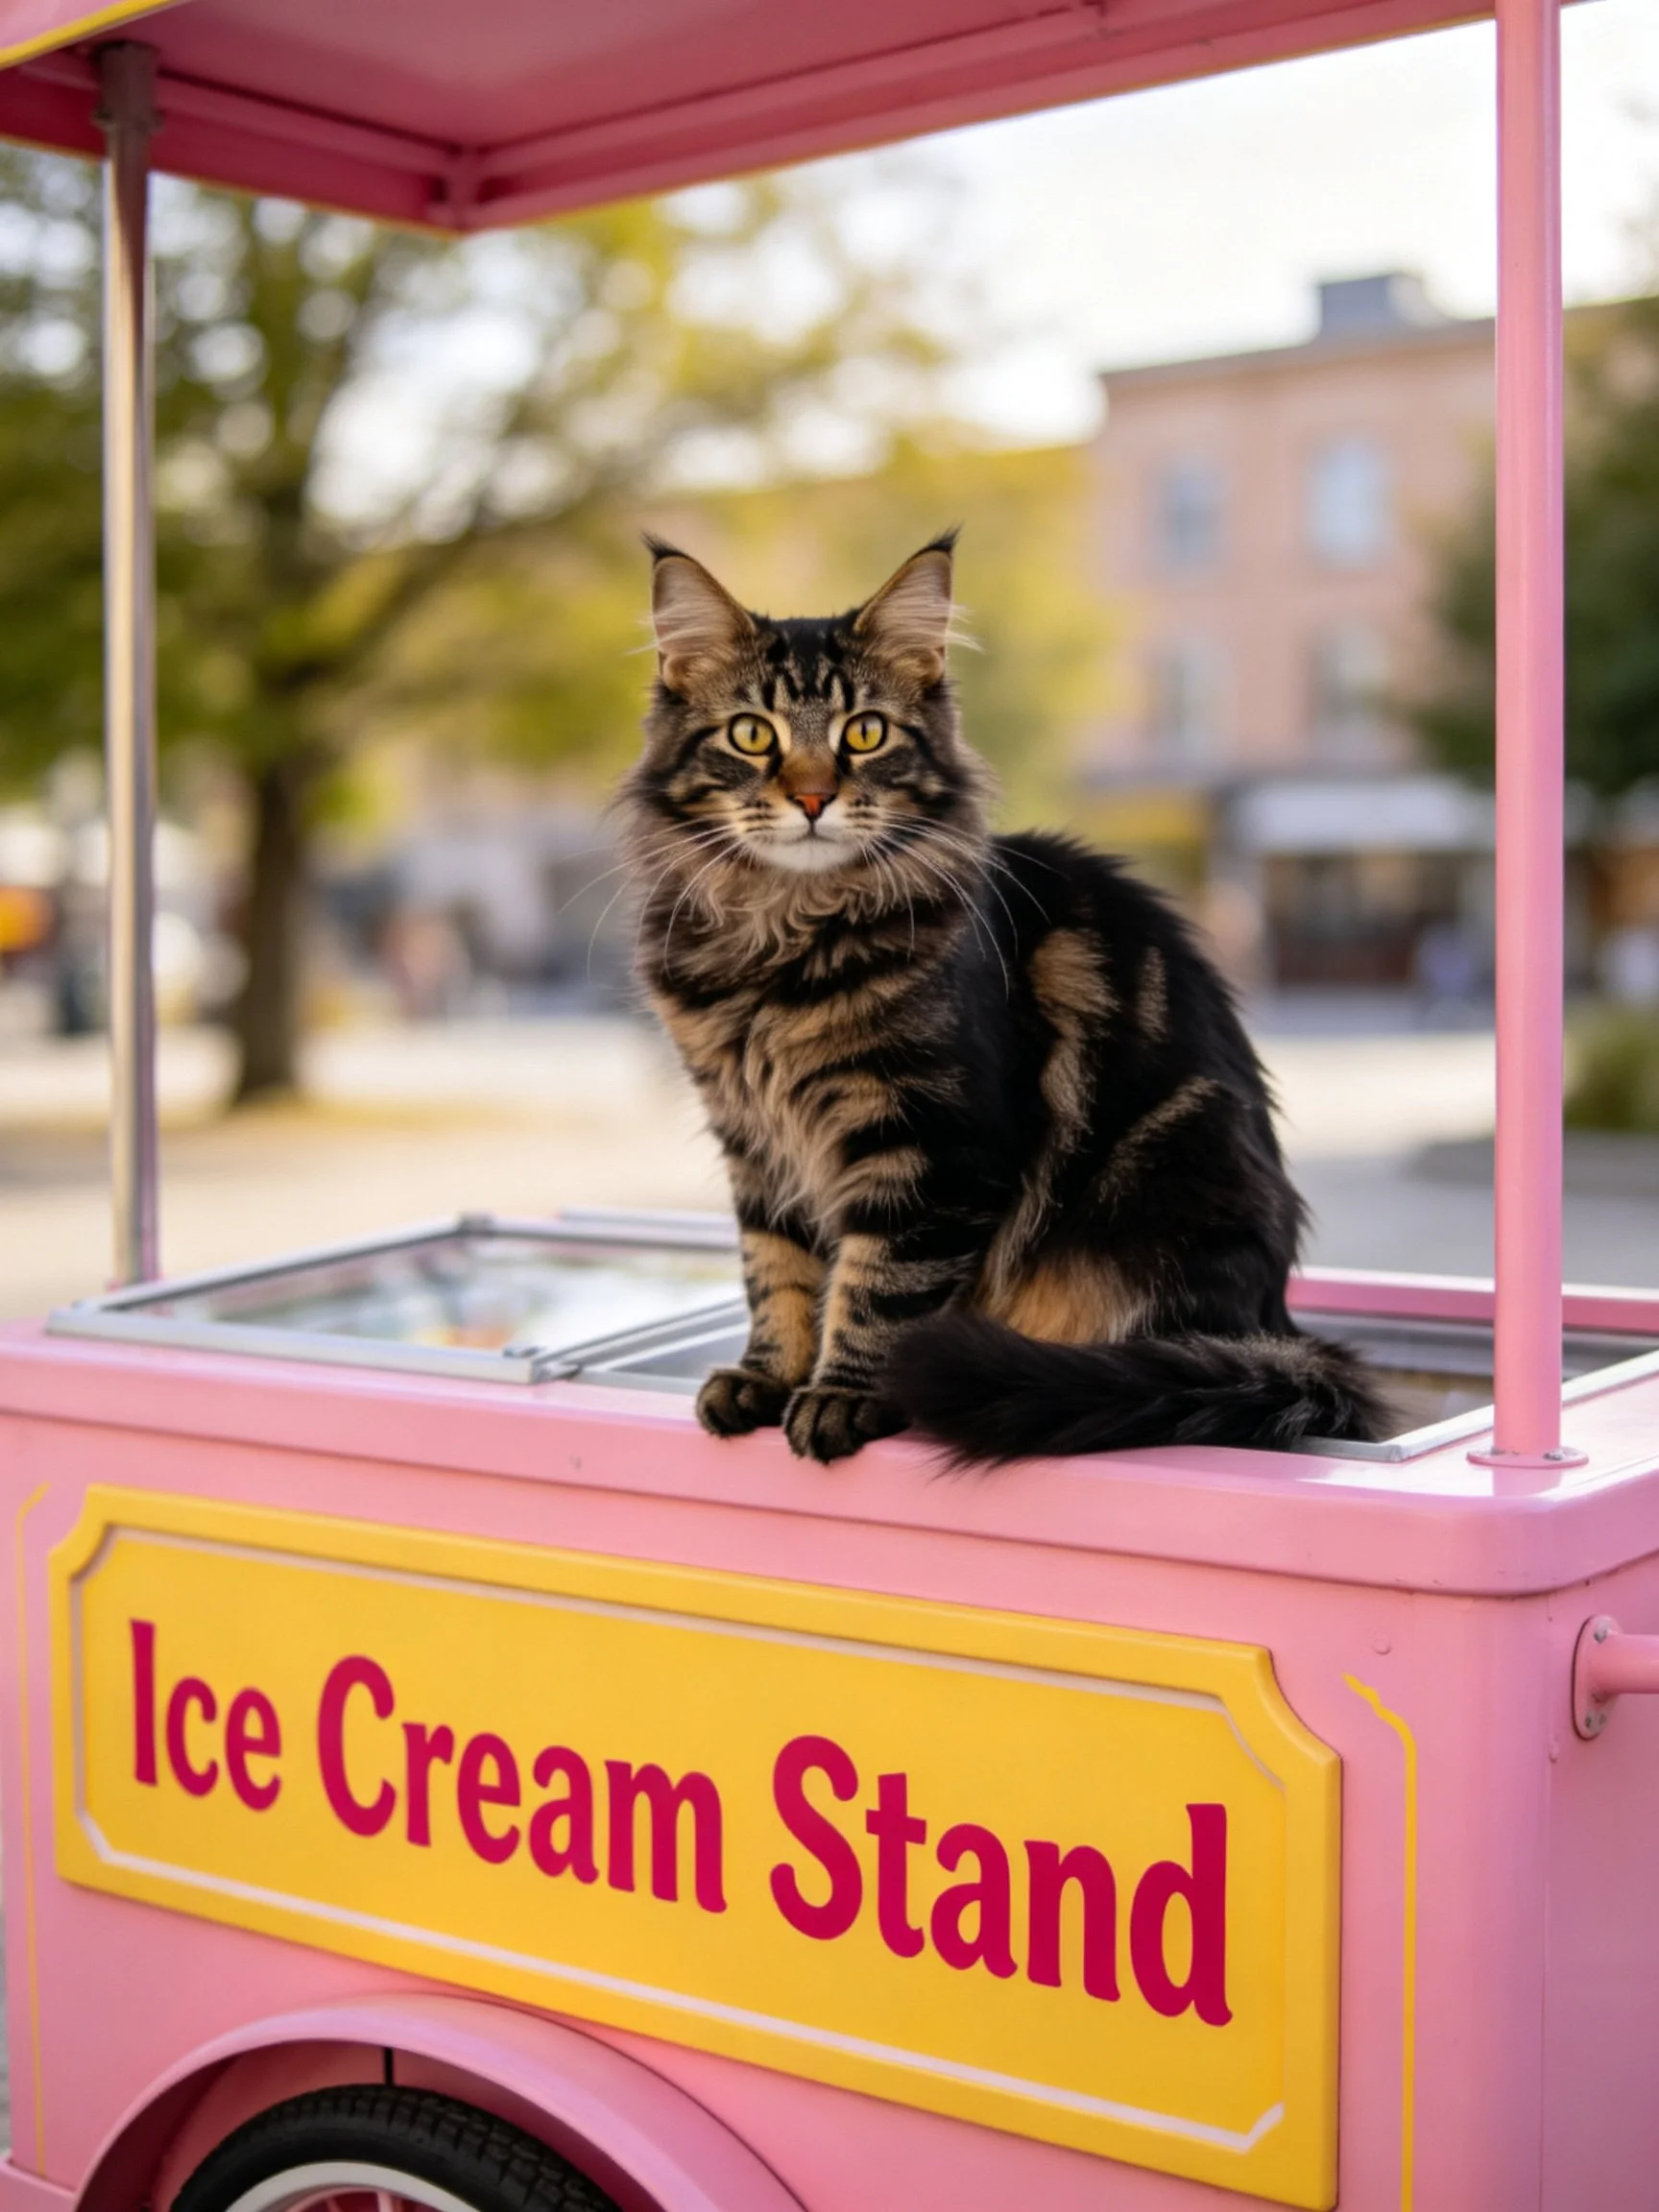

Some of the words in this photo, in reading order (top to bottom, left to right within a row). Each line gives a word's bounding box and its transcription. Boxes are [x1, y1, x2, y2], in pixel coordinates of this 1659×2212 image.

[130, 1620, 281, 1811] Ice
[317, 1656, 726, 1913] Cream
[770, 1736, 1232, 2026] Stand
